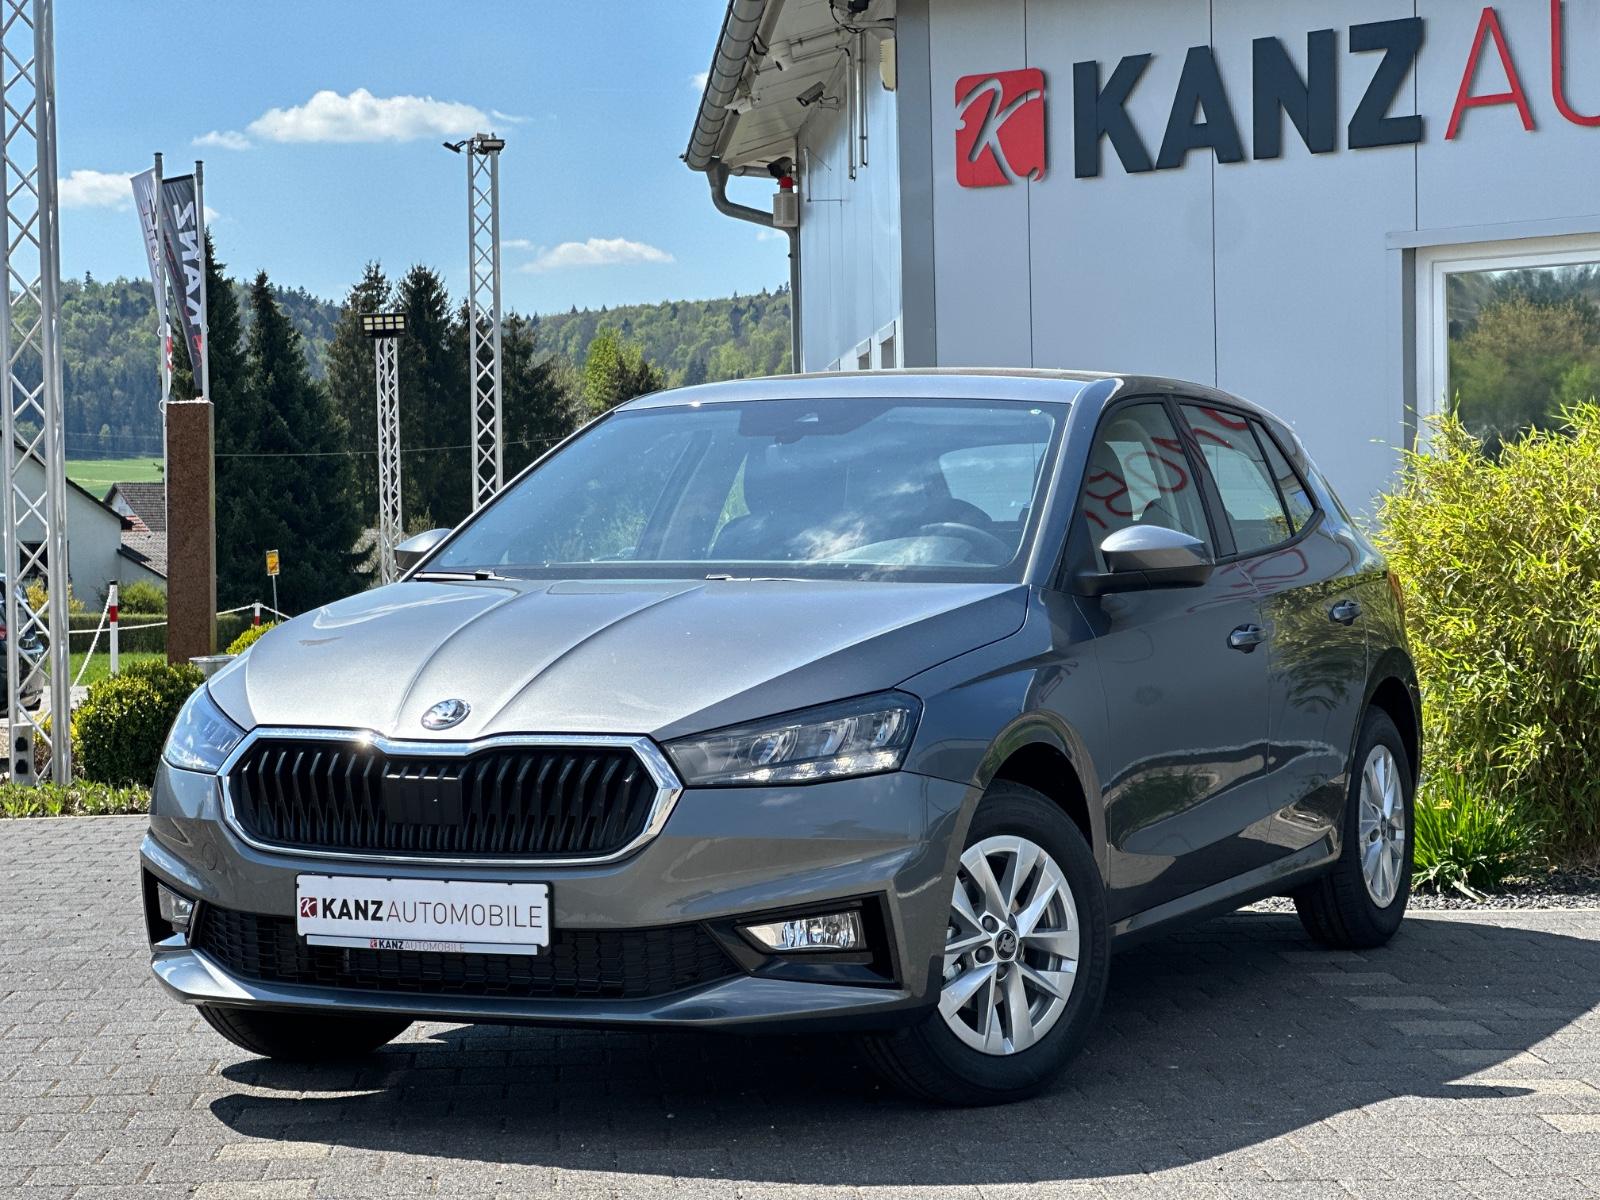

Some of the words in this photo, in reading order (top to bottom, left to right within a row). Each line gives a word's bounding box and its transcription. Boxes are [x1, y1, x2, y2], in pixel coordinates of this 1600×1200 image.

[1073, 17, 1422, 178] KANZ
[322, 898, 384, 921] KANZ
[386, 902, 543, 928] AUTOMOBILE
